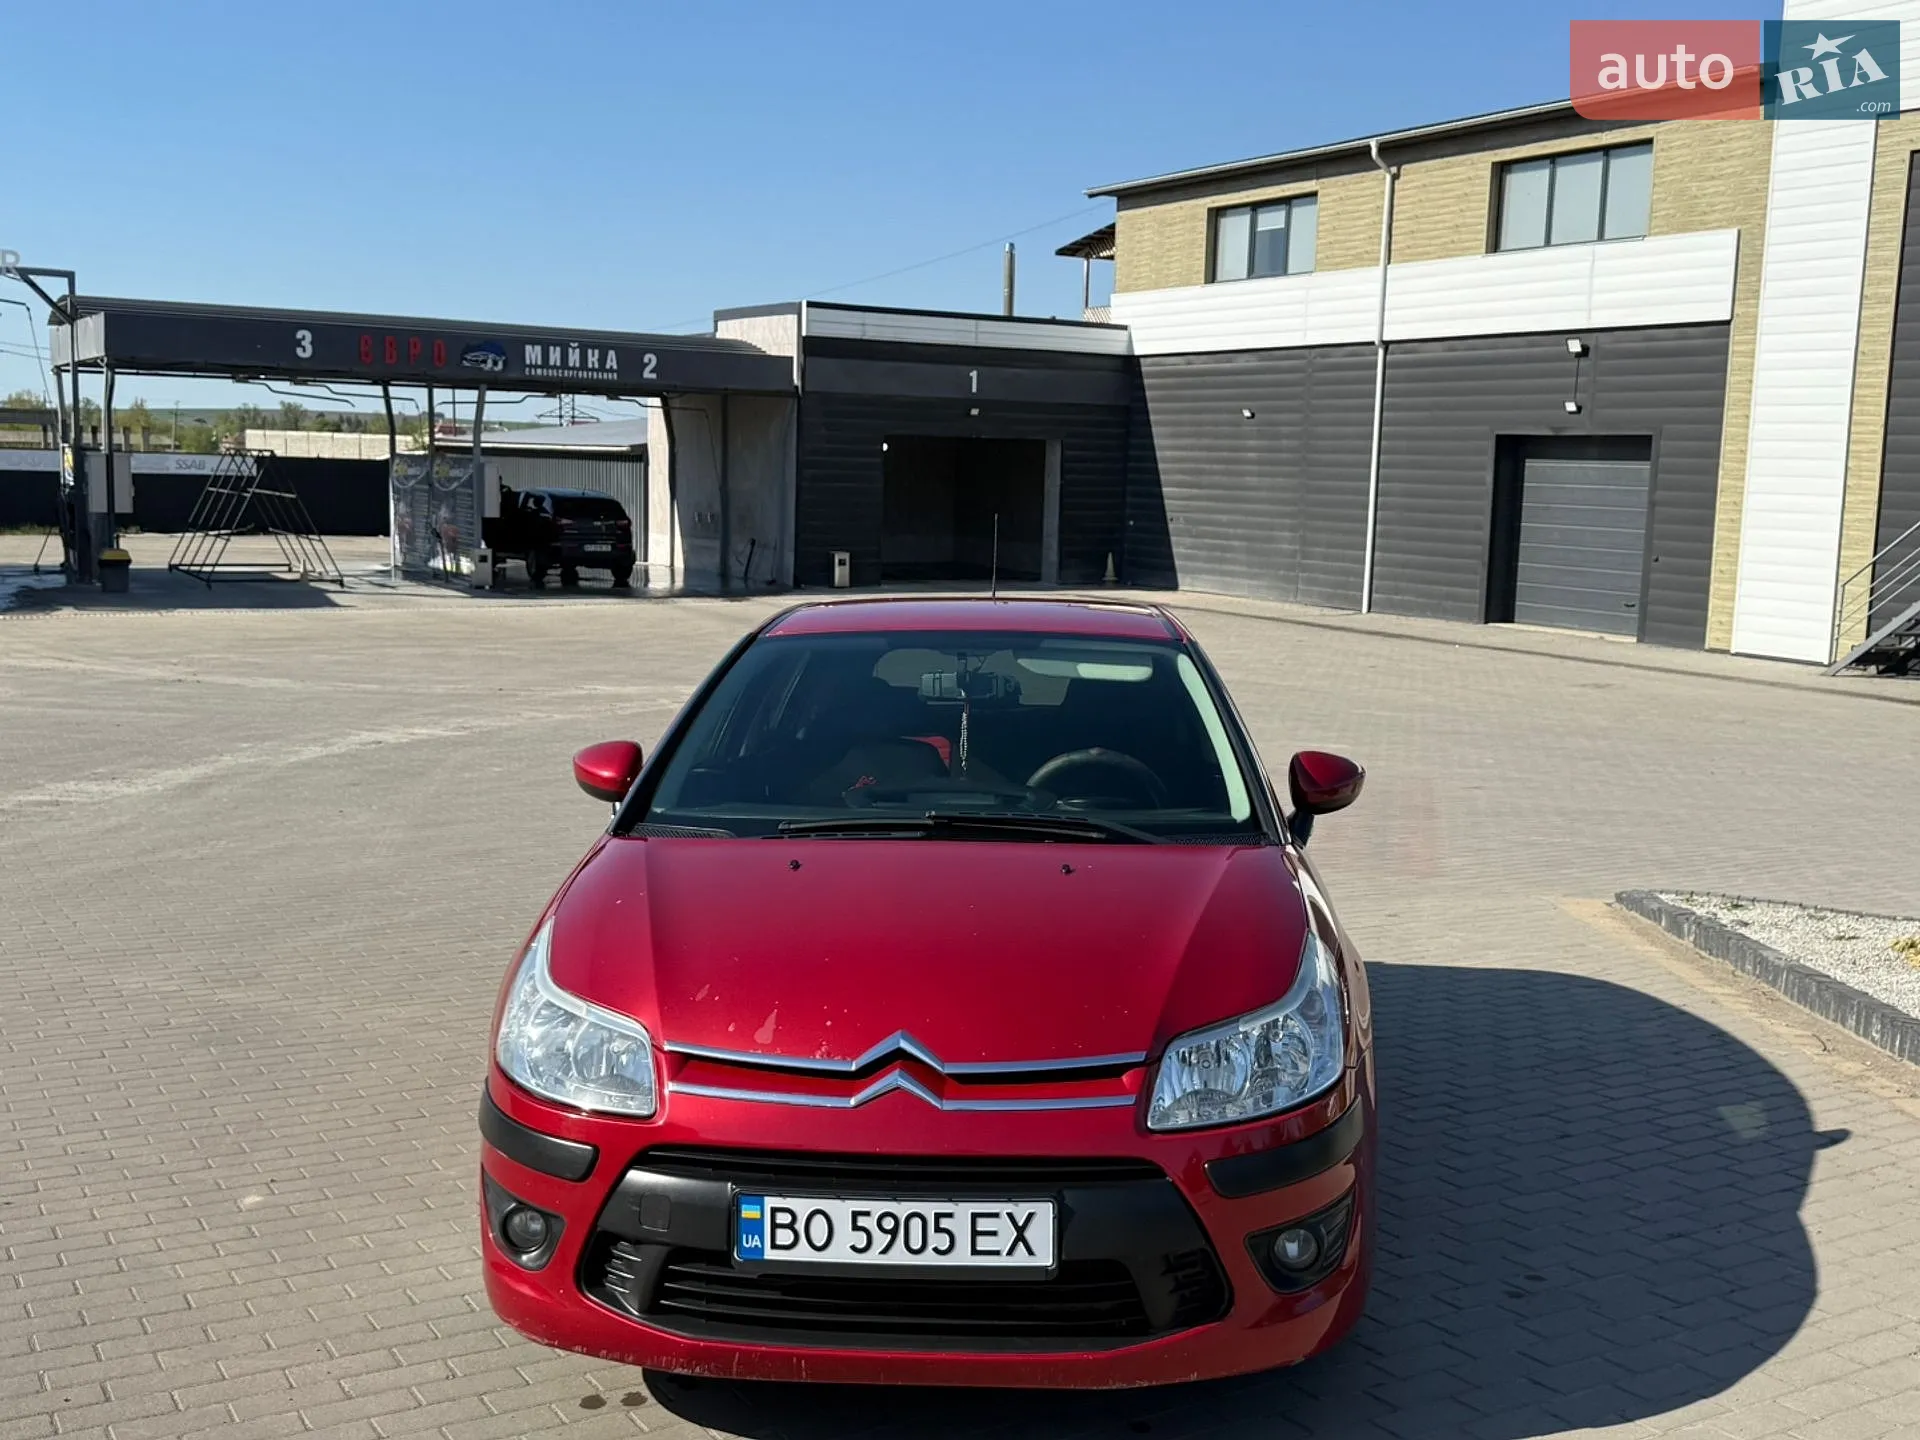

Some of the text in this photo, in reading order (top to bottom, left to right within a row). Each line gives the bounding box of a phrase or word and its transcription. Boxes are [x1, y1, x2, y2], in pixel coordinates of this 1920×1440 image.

[295, 329, 313, 359] 3
[524, 342, 618, 370] МИЙКА
[642, 352, 657, 380] 2
[969, 370, 977, 393] 1
[743, 1235, 762, 1249] UA
[769, 1205, 1037, 1257] BO 5905 EX
